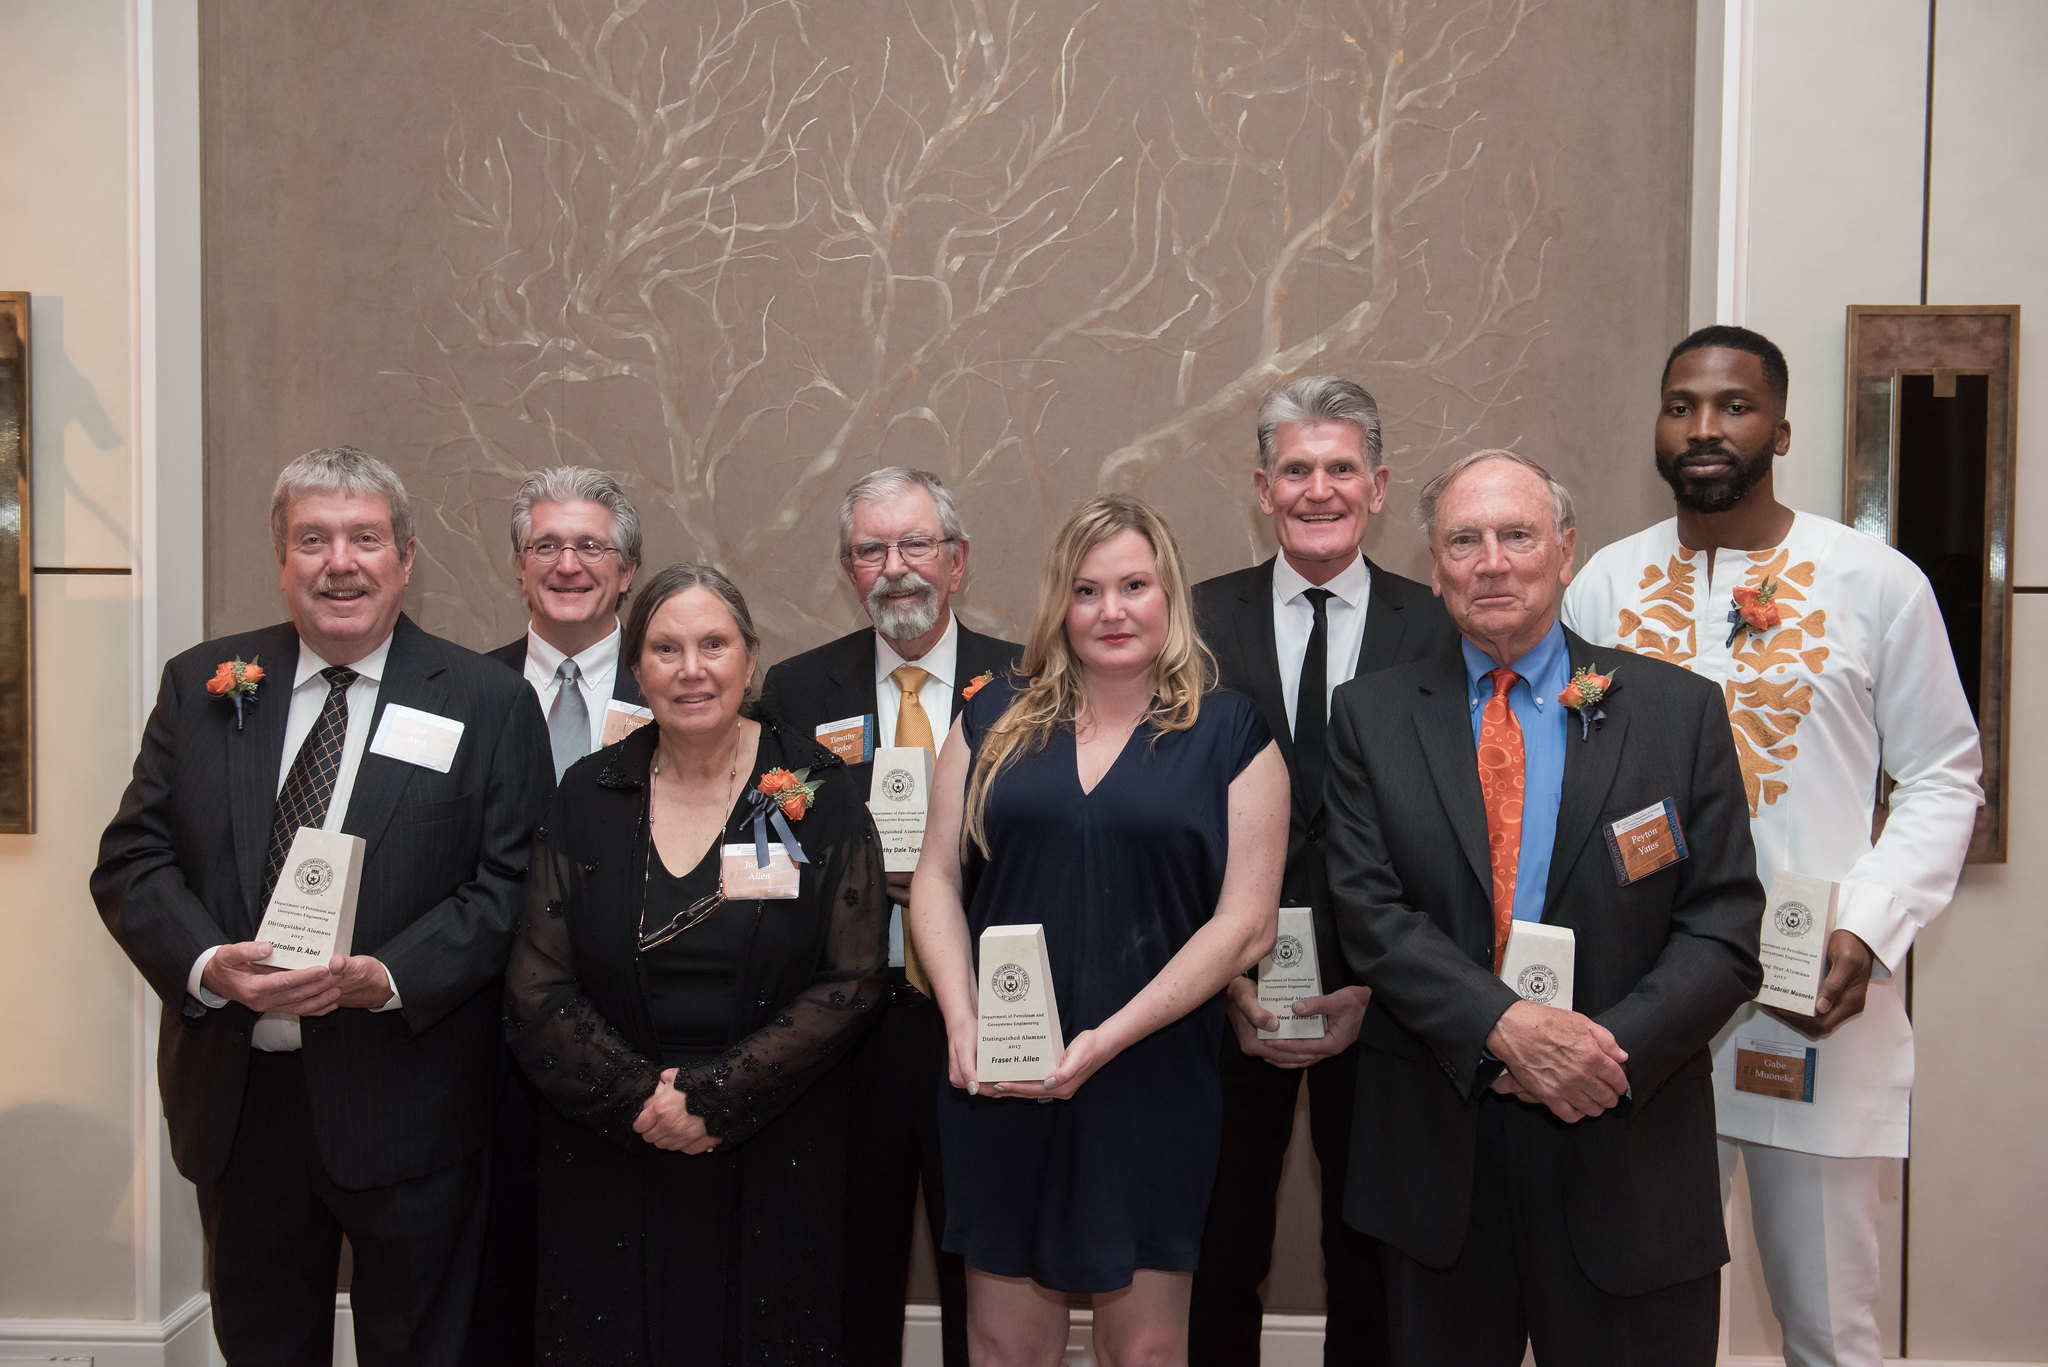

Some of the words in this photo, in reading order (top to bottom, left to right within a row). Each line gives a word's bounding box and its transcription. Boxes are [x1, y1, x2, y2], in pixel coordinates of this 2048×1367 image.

[830, 733, 856, 744] Timothy
[833, 744, 852, 754] Taylor
[1632, 828, 1658, 844] Peyton
[1607, 827, 1628, 880] SUPPORTER
[1638, 842, 1659, 855] Yates
[268, 920, 305, 932] Distinguished
[306, 928, 331, 936] Alumnus
[305, 948, 321, 957] Abel
[1786, 968, 1810, 978] Alumnus
[1770, 985, 1790, 994] Gabriel
[1764, 1059, 1786, 1069] Gabe
[1755, 1069, 1794, 1083] Muoneke
